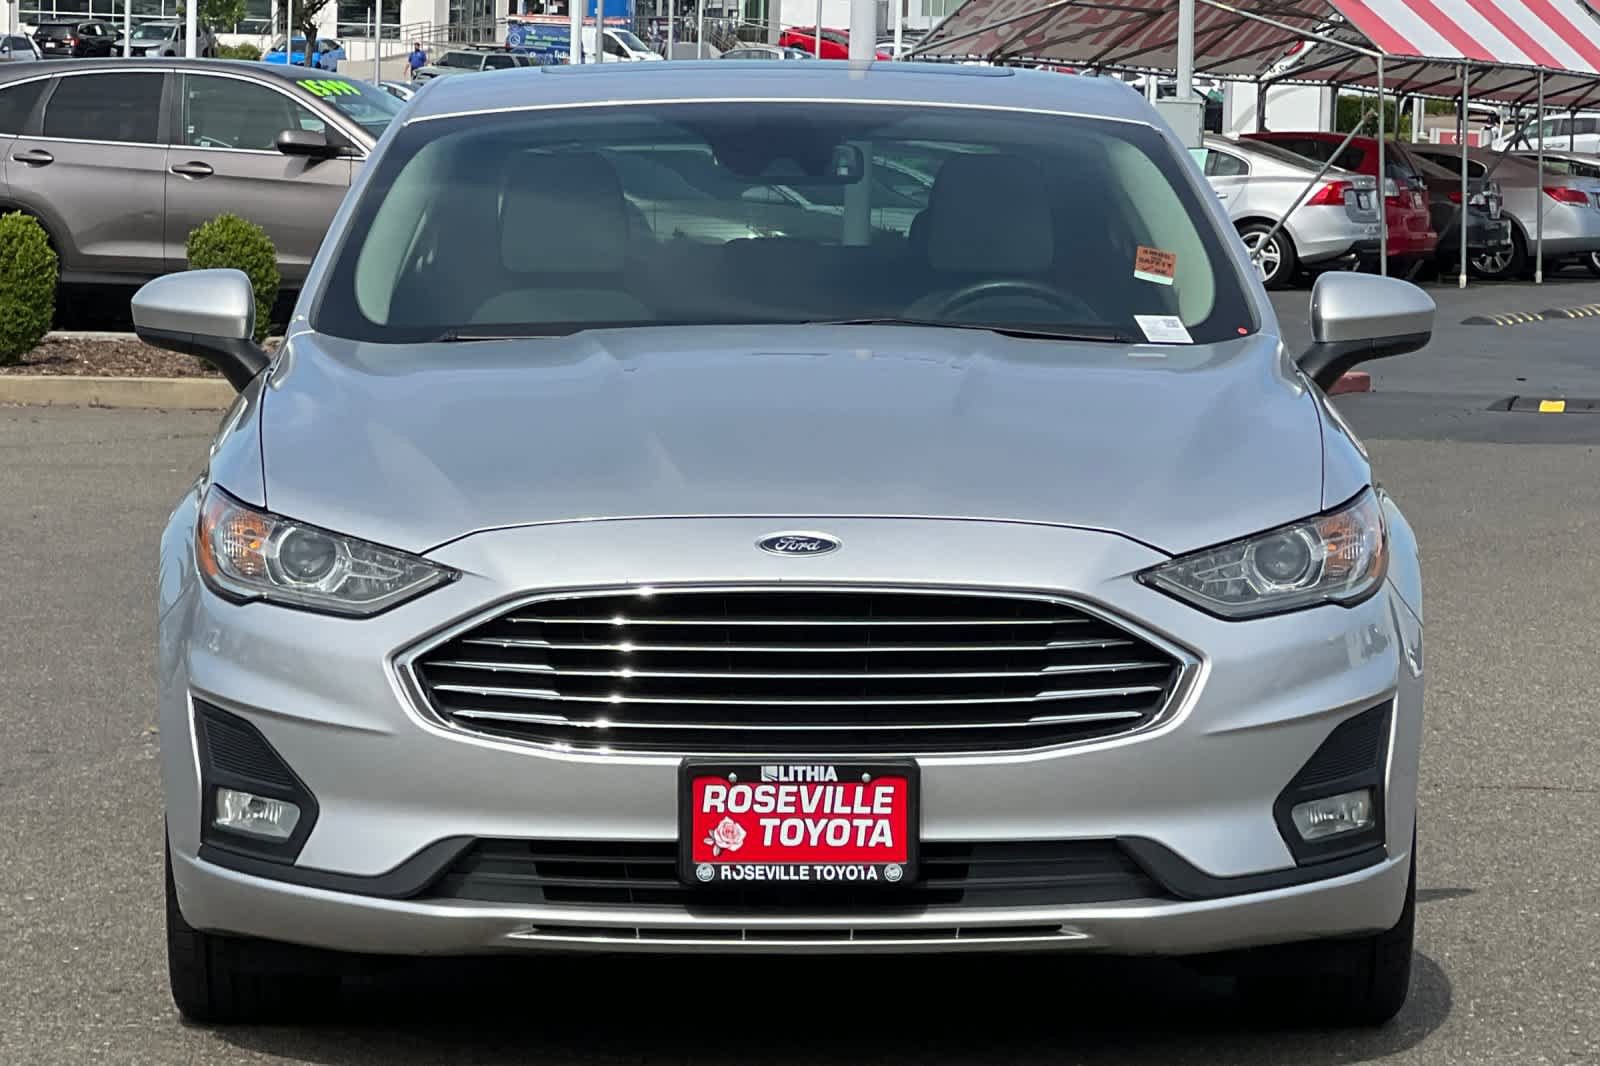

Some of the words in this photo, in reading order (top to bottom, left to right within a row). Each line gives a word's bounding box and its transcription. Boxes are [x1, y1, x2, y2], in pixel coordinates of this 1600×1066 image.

[775, 536, 821, 550] Ford
[779, 766, 838, 782] LITHIA
[702, 784, 894, 814] ROSEVILLE
[760, 818, 894, 847] TOYOTA
[721, 865, 810, 880] ROSEVILLE
[814, 865, 878, 880] TOYOTA
